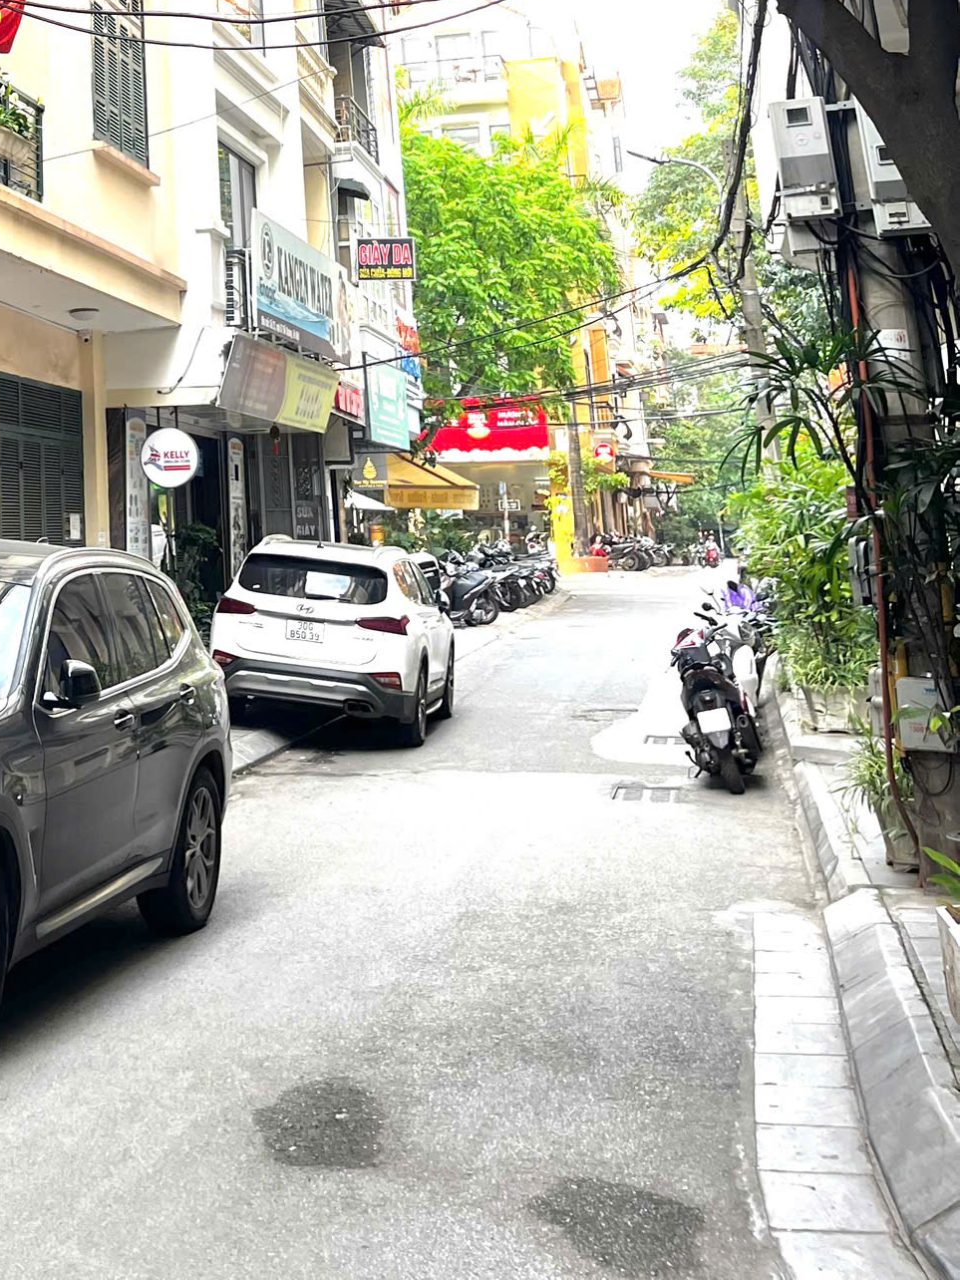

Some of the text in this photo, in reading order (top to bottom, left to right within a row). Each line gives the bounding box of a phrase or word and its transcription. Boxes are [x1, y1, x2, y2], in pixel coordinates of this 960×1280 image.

[358, 240, 412, 266] GIÀY DA
[277, 246, 334, 320] KANGEN WATER
[163, 450, 190, 459] KELLY
